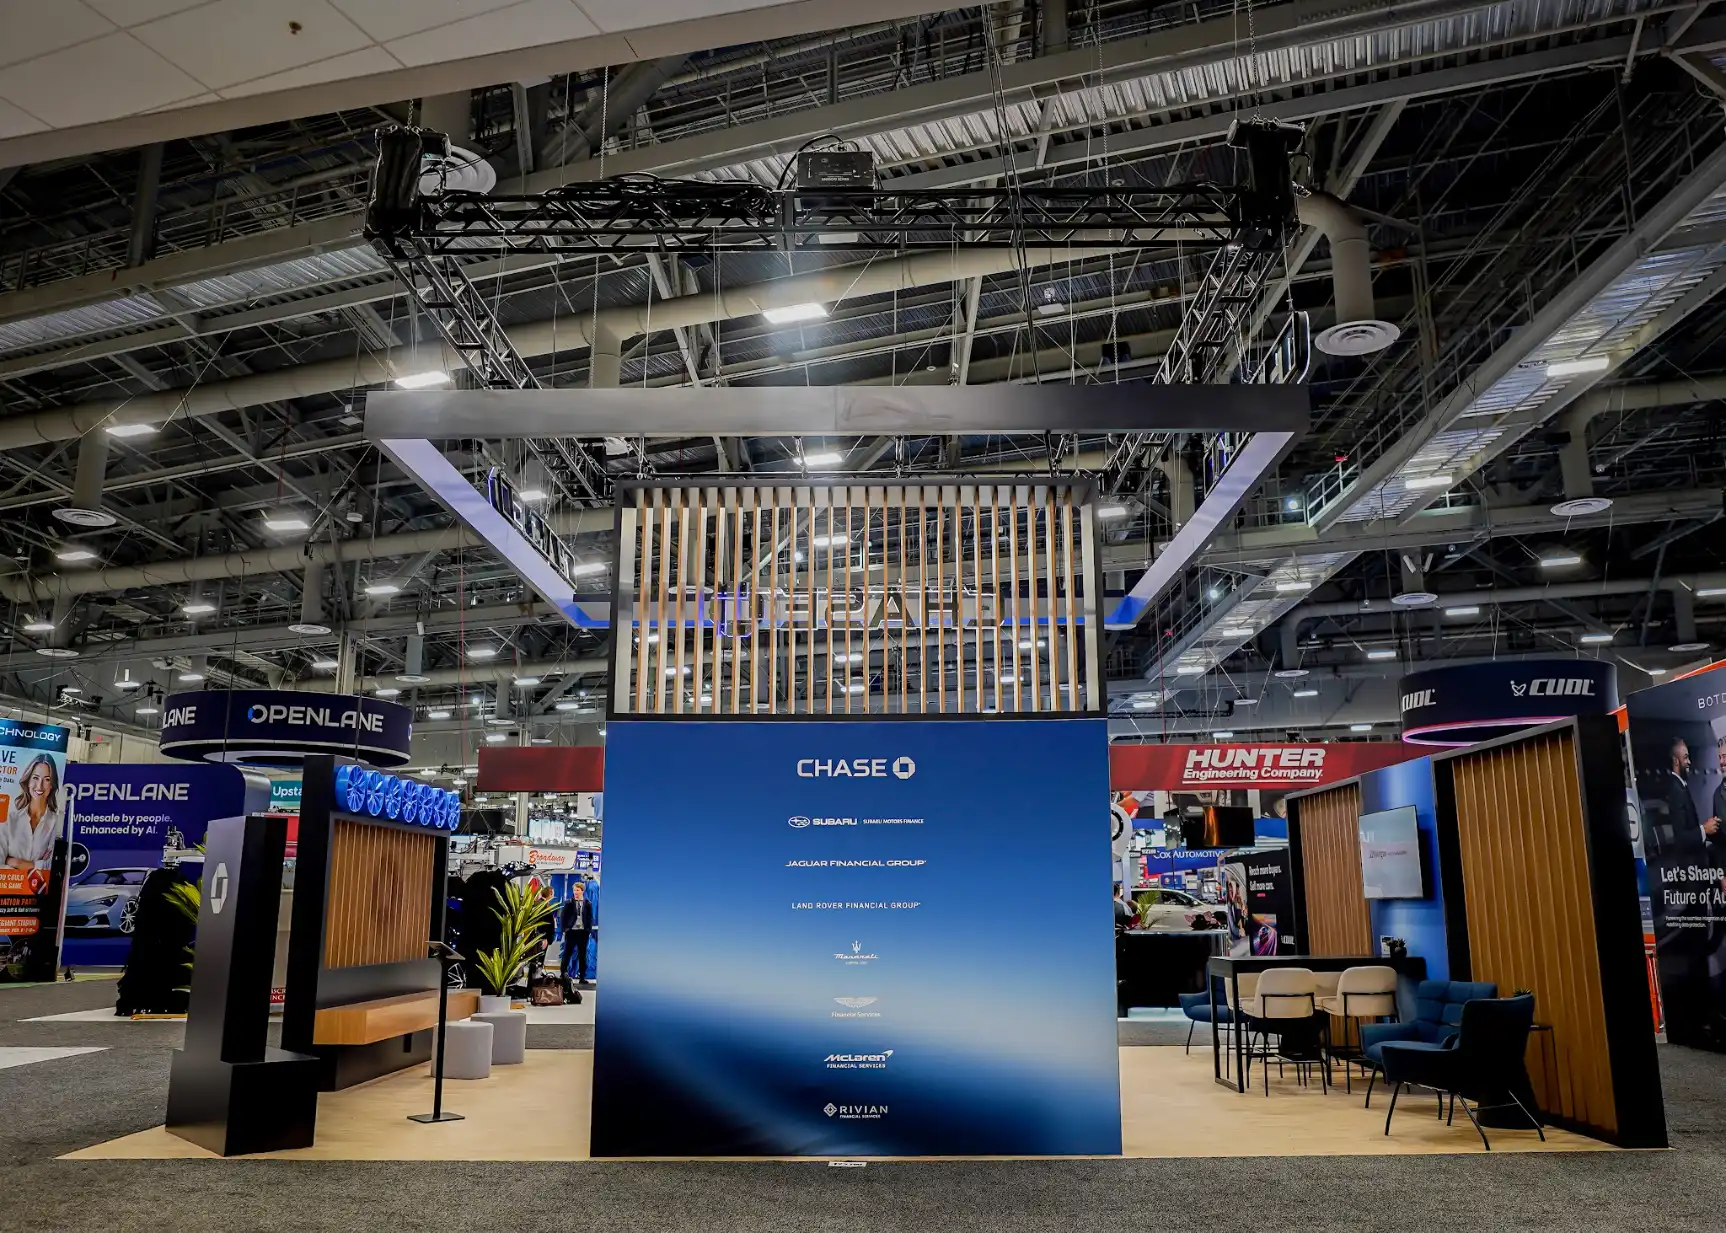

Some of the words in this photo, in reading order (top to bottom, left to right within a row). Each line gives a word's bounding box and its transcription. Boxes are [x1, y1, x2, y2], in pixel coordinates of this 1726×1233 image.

[1529, 678, 1596, 697] CUDL
[247, 703, 384, 733] OPENLANE
[1185, 748, 1326, 768] HUNTER
[796, 758, 888, 777] CHASE
[1183, 767, 1259, 780] Engineering
[63, 783, 190, 801] OPENLANE
[122, 813, 135, 825] by
[136, 813, 173, 825] people.
[812, 818, 858, 826] SUBARU
[80, 825, 130, 835] Enhanced
[131, 825, 144, 837] by
[146, 825, 158, 835] AI.
[1660, 866, 1686, 882] Let's
[1687, 865, 1725, 885] Shape
[1663, 889, 1697, 905] Future
[1699, 888, 1711, 904] of
[824, 1054, 887, 1062] McLaren
[839, 1105, 889, 1114] RIVIAN
